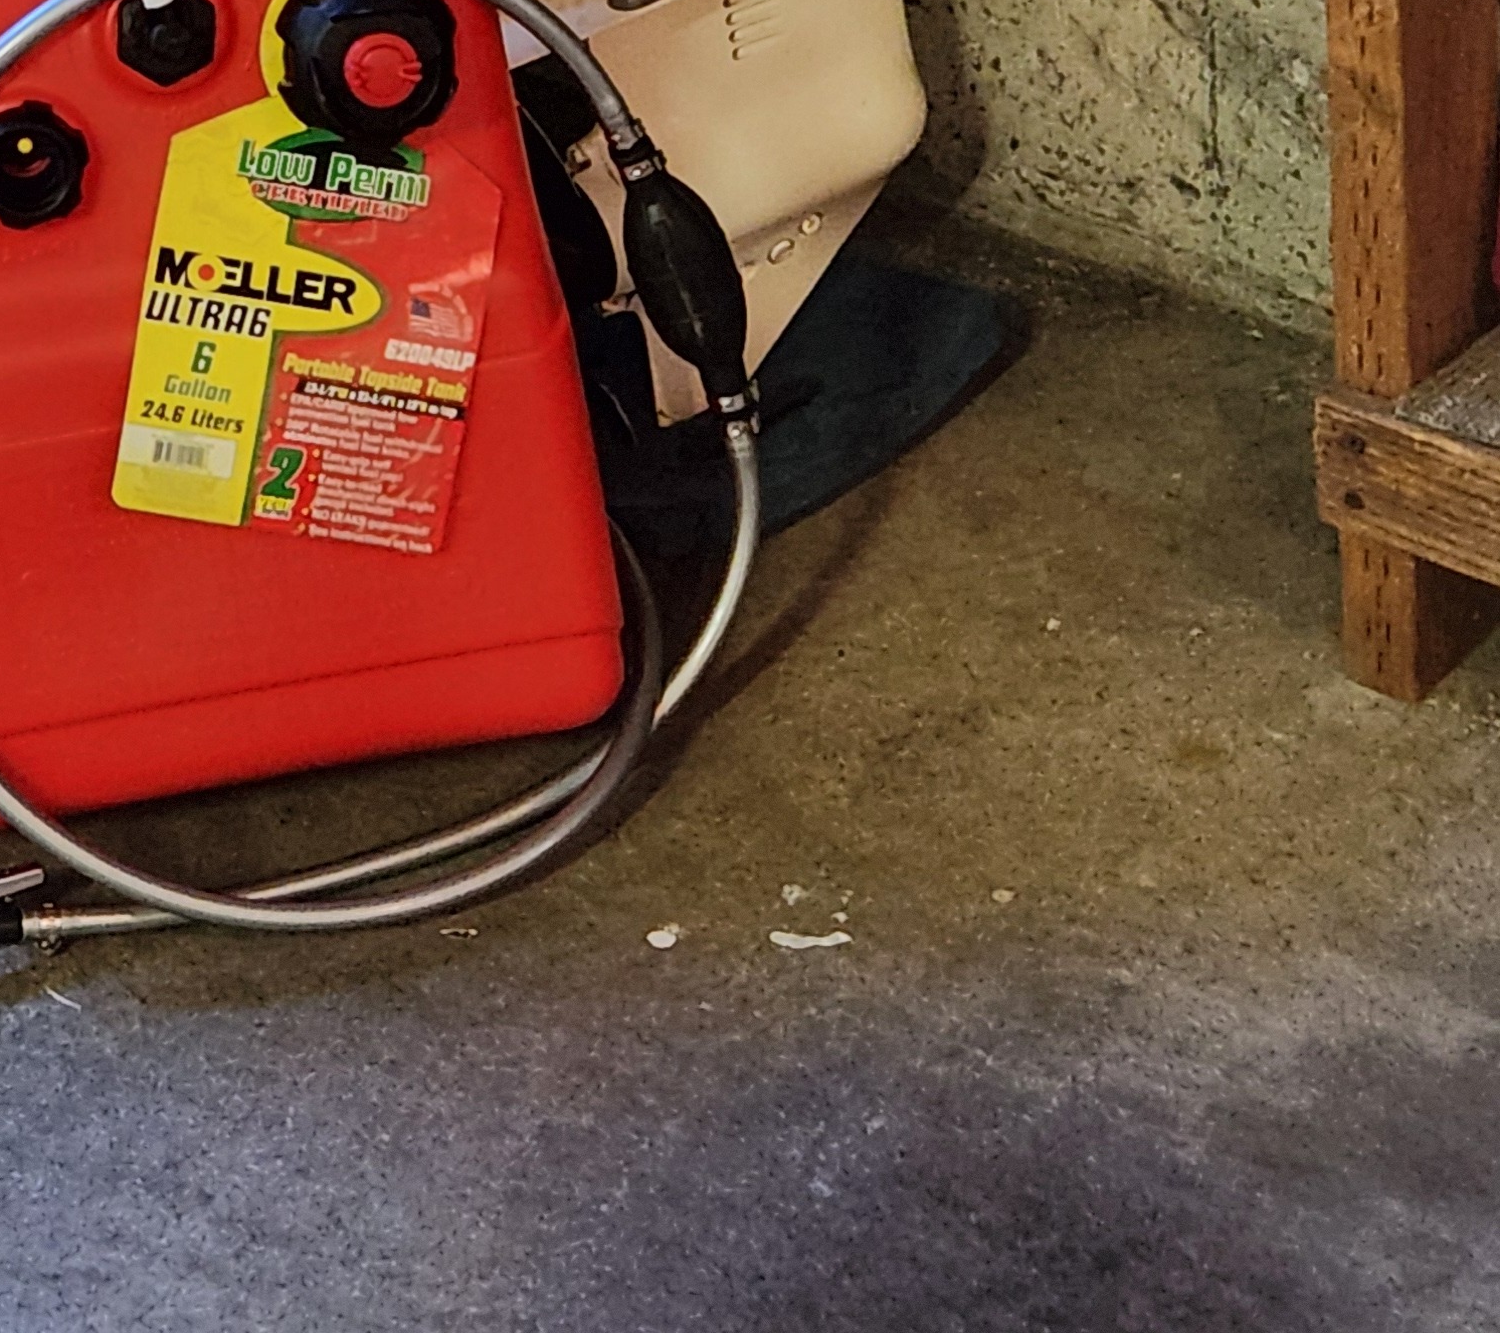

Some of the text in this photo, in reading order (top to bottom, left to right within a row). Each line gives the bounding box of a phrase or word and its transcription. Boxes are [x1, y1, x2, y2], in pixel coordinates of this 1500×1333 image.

[237, 139, 431, 207] Low Perm
[250, 180, 408, 221] CERTIFIED
[154, 246, 357, 315] MOELLER
[190, 341, 217, 374] 6
[164, 374, 232, 404] Gallon
[140, 400, 244, 433] 24.6 Liters
[259, 445, 306, 499] 2
